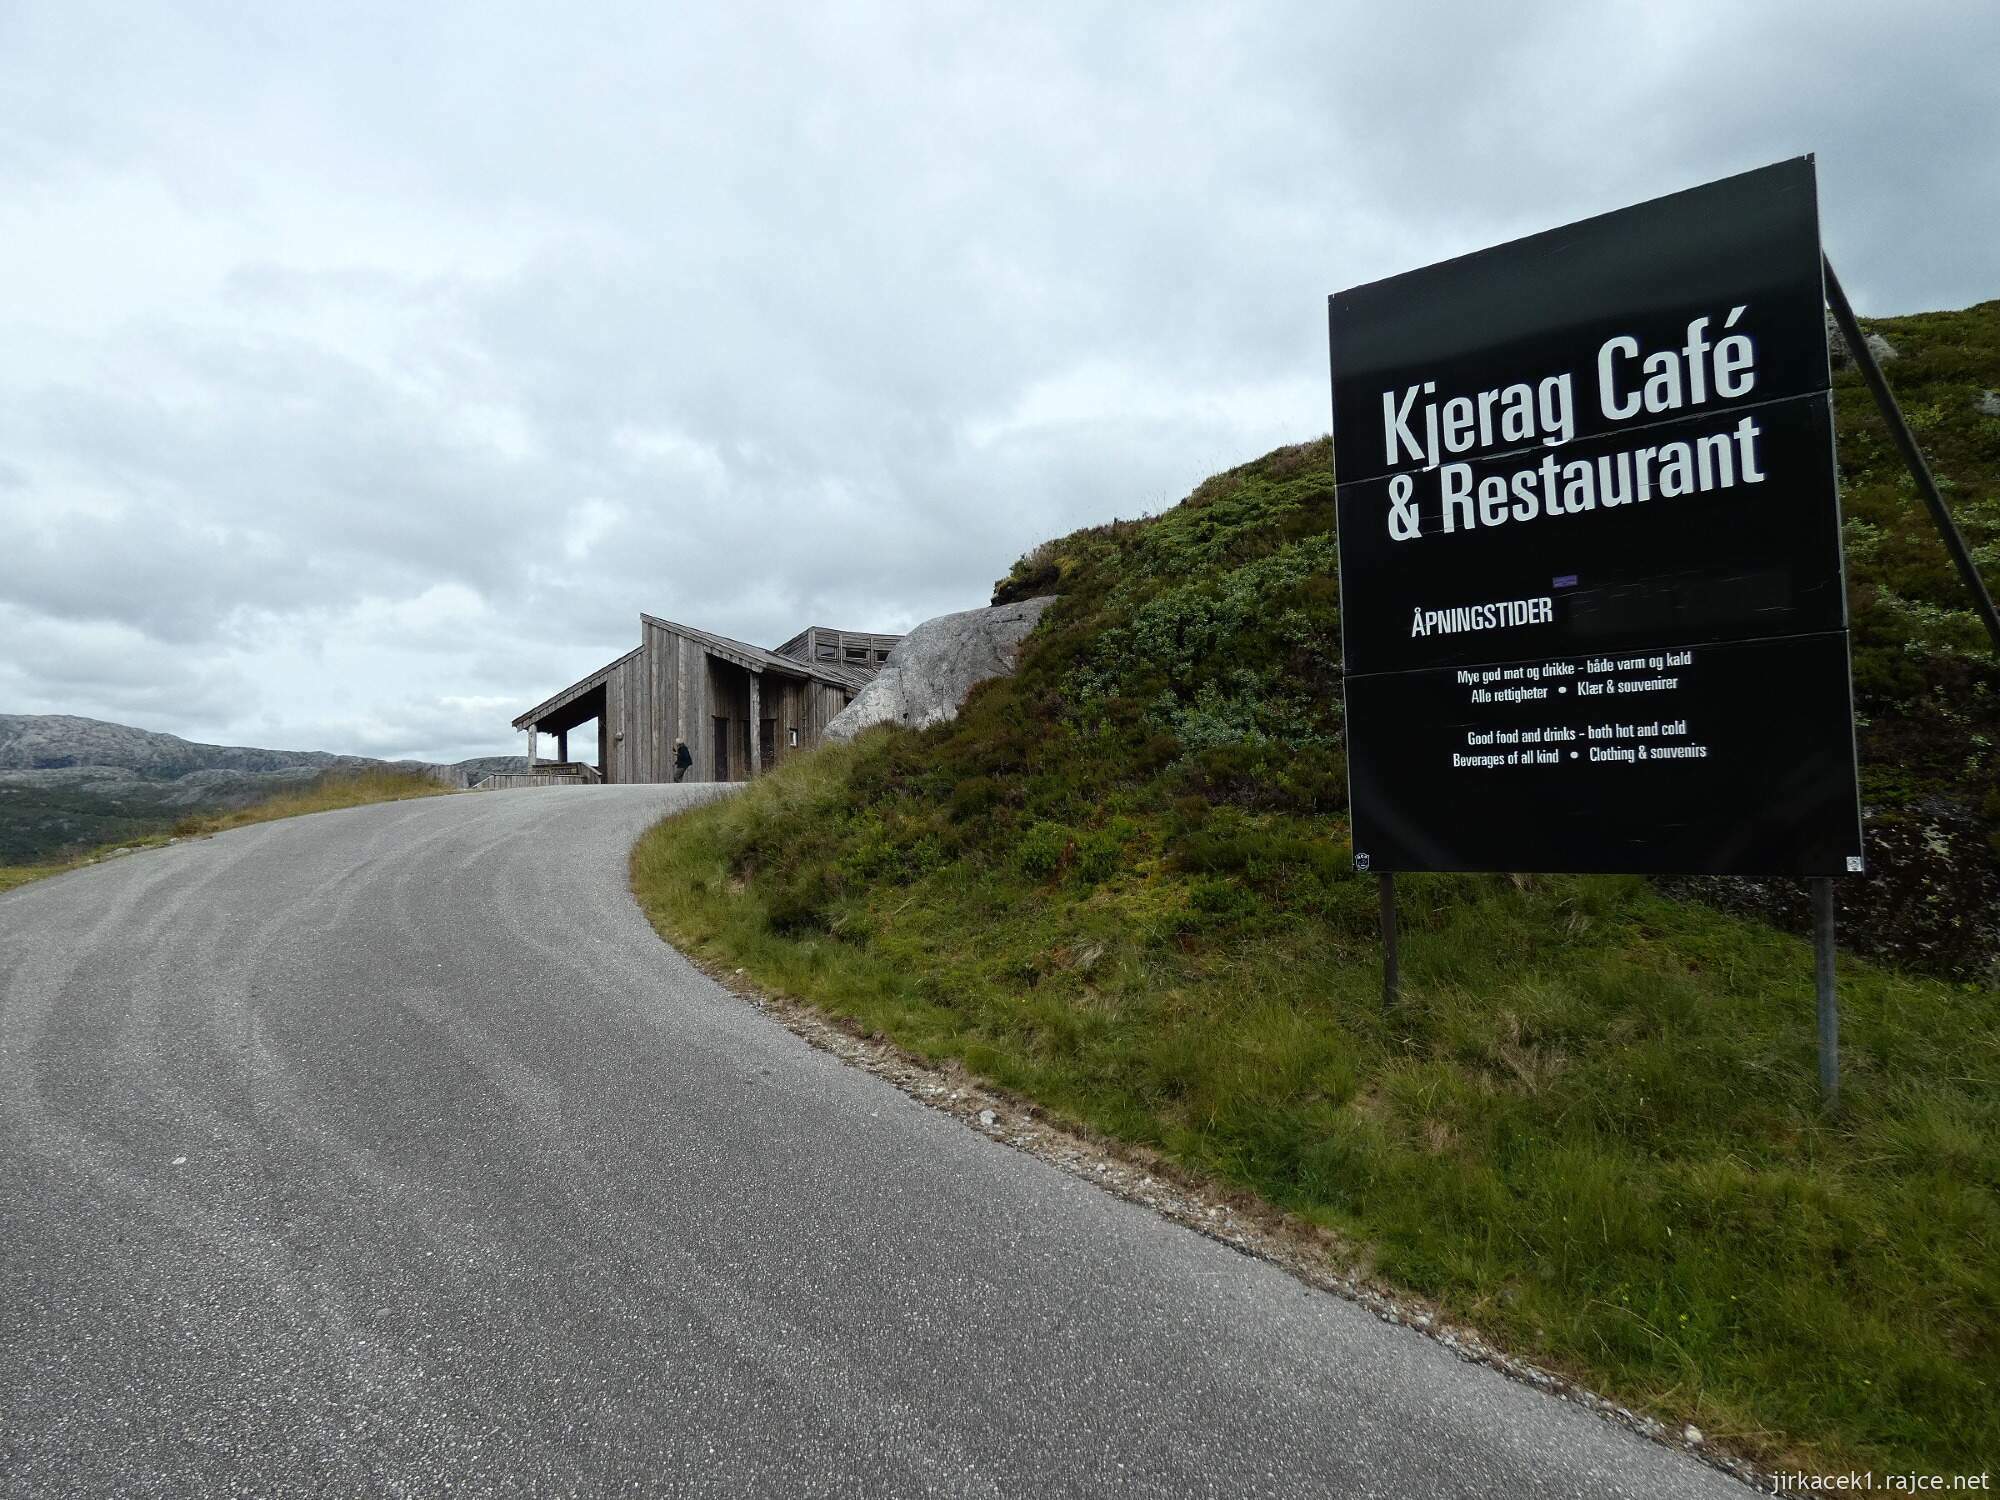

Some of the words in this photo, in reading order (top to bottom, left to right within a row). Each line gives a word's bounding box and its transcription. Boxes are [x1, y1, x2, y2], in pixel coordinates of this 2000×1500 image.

[1383, 373, 1575, 472] Kjerag
[1598, 305, 1755, 421] Café
[1388, 474, 1422, 541] &
[1441, 416, 1765, 533] Restaurant
[1412, 597, 1552, 637] ÅPNINGSTIDER
[1458, 671, 1479, 685] Mye
[1483, 668, 1501, 684] god
[1504, 667, 1524, 679] mat
[1527, 668, 1539, 680] og
[1543, 662, 1574, 676] drikke
[1587, 658, 1614, 673] både
[1617, 659, 1645, 670] varm
[1649, 657, 1663, 670] og
[1667, 651, 1691, 666] kald
[1471, 689, 1493, 703] Alle
[1494, 686, 1548, 703] rettigheter
[1578, 682, 1603, 695] Klær
[1607, 680, 1615, 693] &
[1618, 676, 1678, 693] souvenirer
[1468, 731, 1493, 745] Good
[1496, 729, 1518, 743] food
[1522, 728, 1541, 742] and
[1544, 727, 1575, 741] drinks
[1588, 724, 1612, 739] both
[1616, 724, 1635, 738] hot
[1637, 722, 1658, 736] and
[1662, 720, 1686, 735] cold
[1453, 753, 1504, 768] Beverages
[1508, 751, 1518, 764] of
[1521, 750, 1533, 764] all
[1537, 749, 1559, 763] kind
[1590, 746, 1635, 763] Clothing
[1638, 745, 1648, 759] &
[1650, 743, 1707, 758] souvenirs
